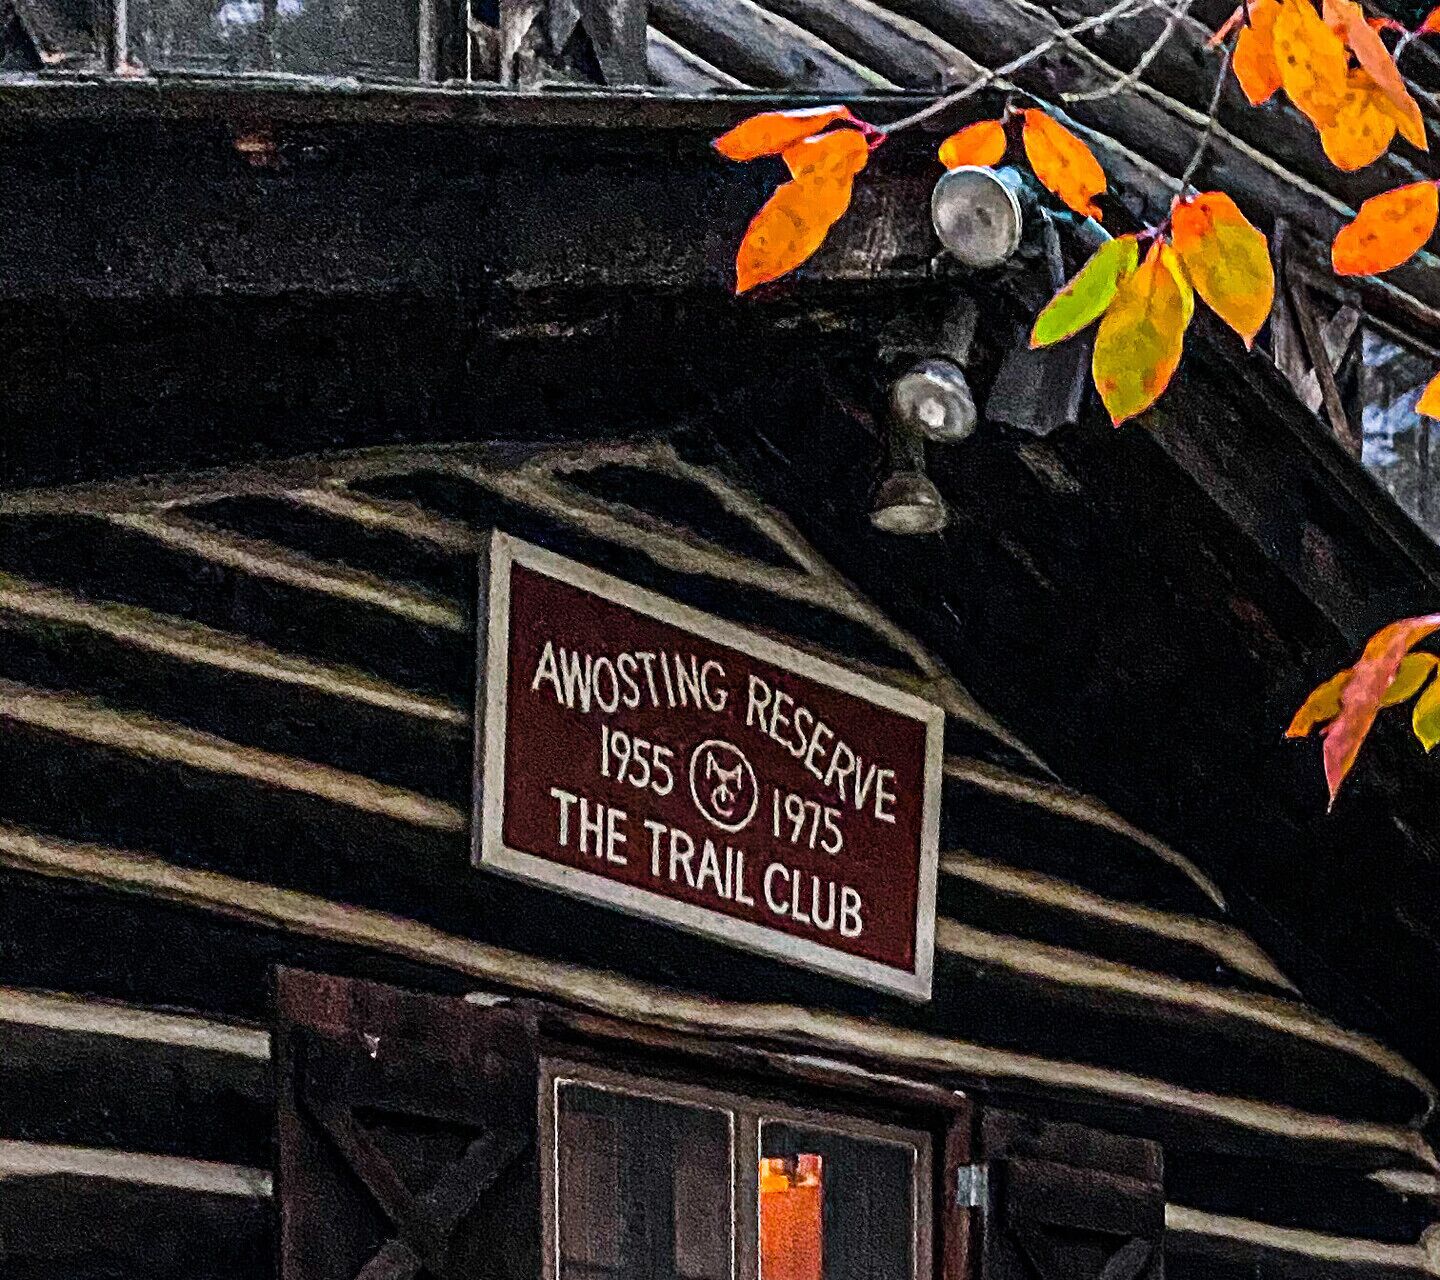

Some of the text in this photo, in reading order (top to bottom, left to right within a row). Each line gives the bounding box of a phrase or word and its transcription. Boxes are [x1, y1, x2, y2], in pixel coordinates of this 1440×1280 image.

[531, 641, 898, 823] AWOSTING RESERVE
[601, 725, 844, 856] 1955 1975
[550, 787, 864, 938] THE TRAIL CLUB
